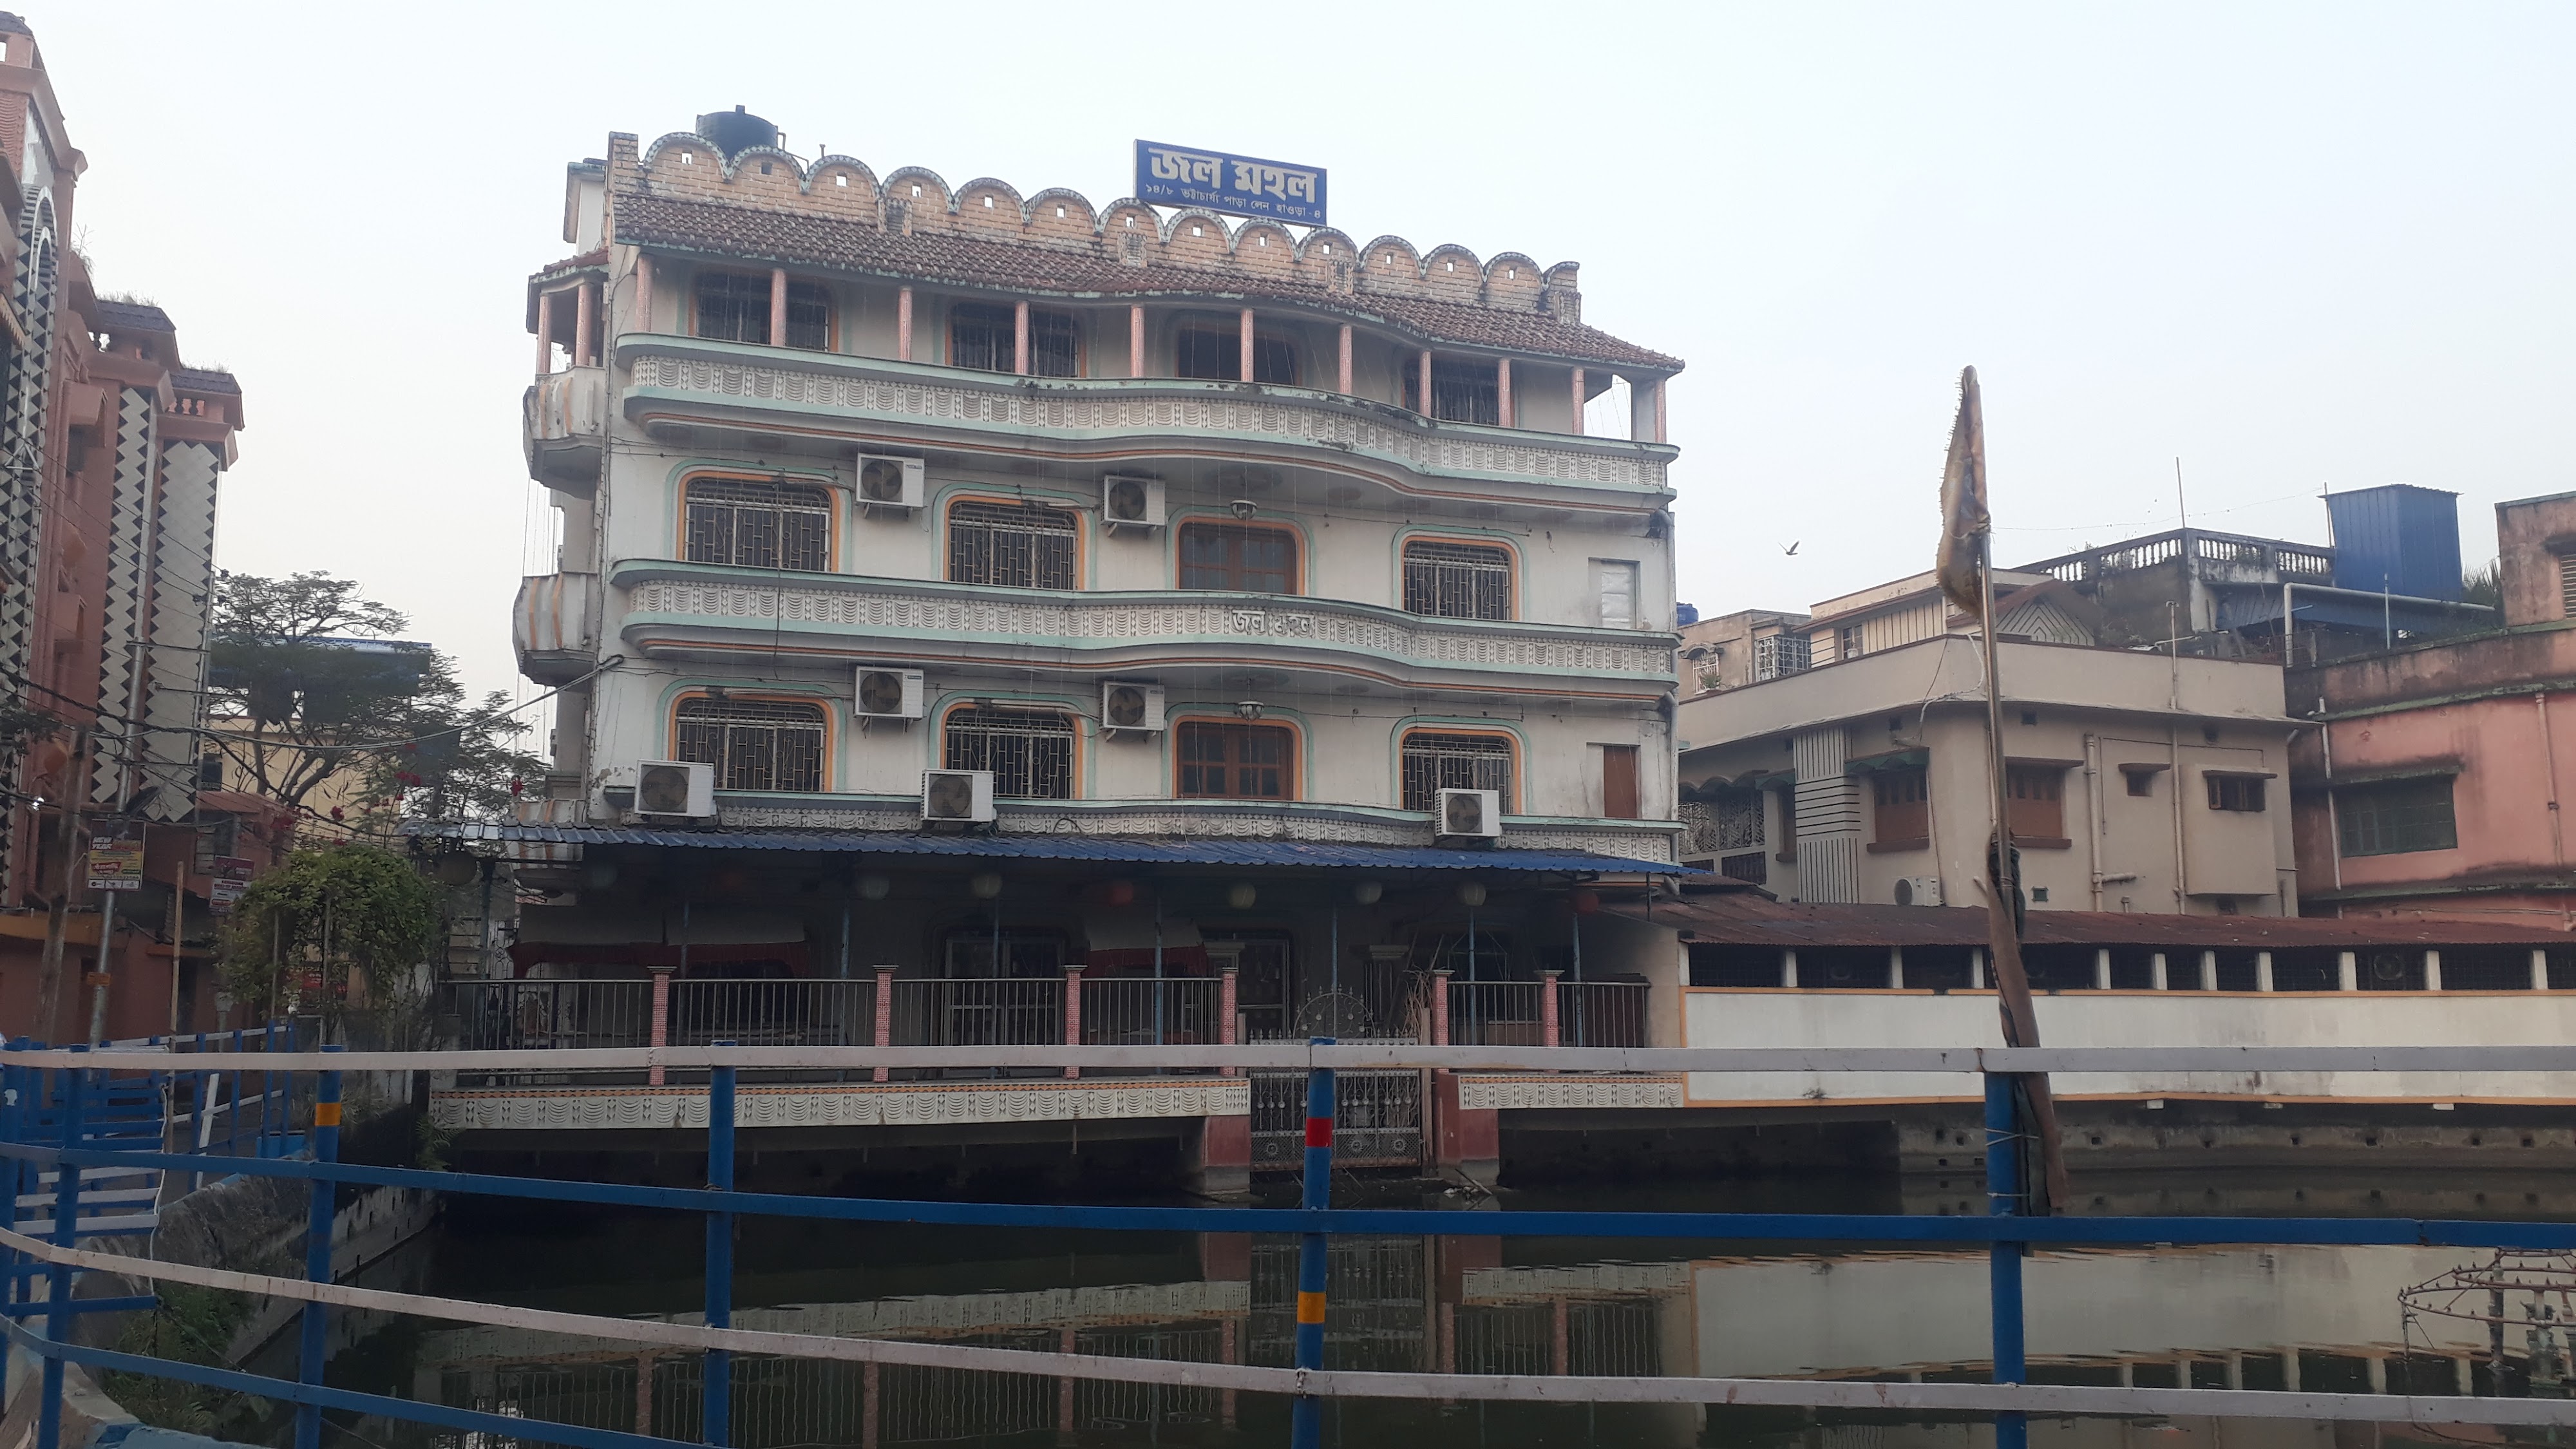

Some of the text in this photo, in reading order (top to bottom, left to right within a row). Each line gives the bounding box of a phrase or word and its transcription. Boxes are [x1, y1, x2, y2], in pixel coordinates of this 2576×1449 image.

[1148, 147, 1317, 203] জল মহল
[1146, 184, 1174, 195] ১৪/৮
[1224, 196, 1246, 208] পাড়া
[1251, 200, 1269, 211] লেন
[1231, 610, 1265, 635] জল
